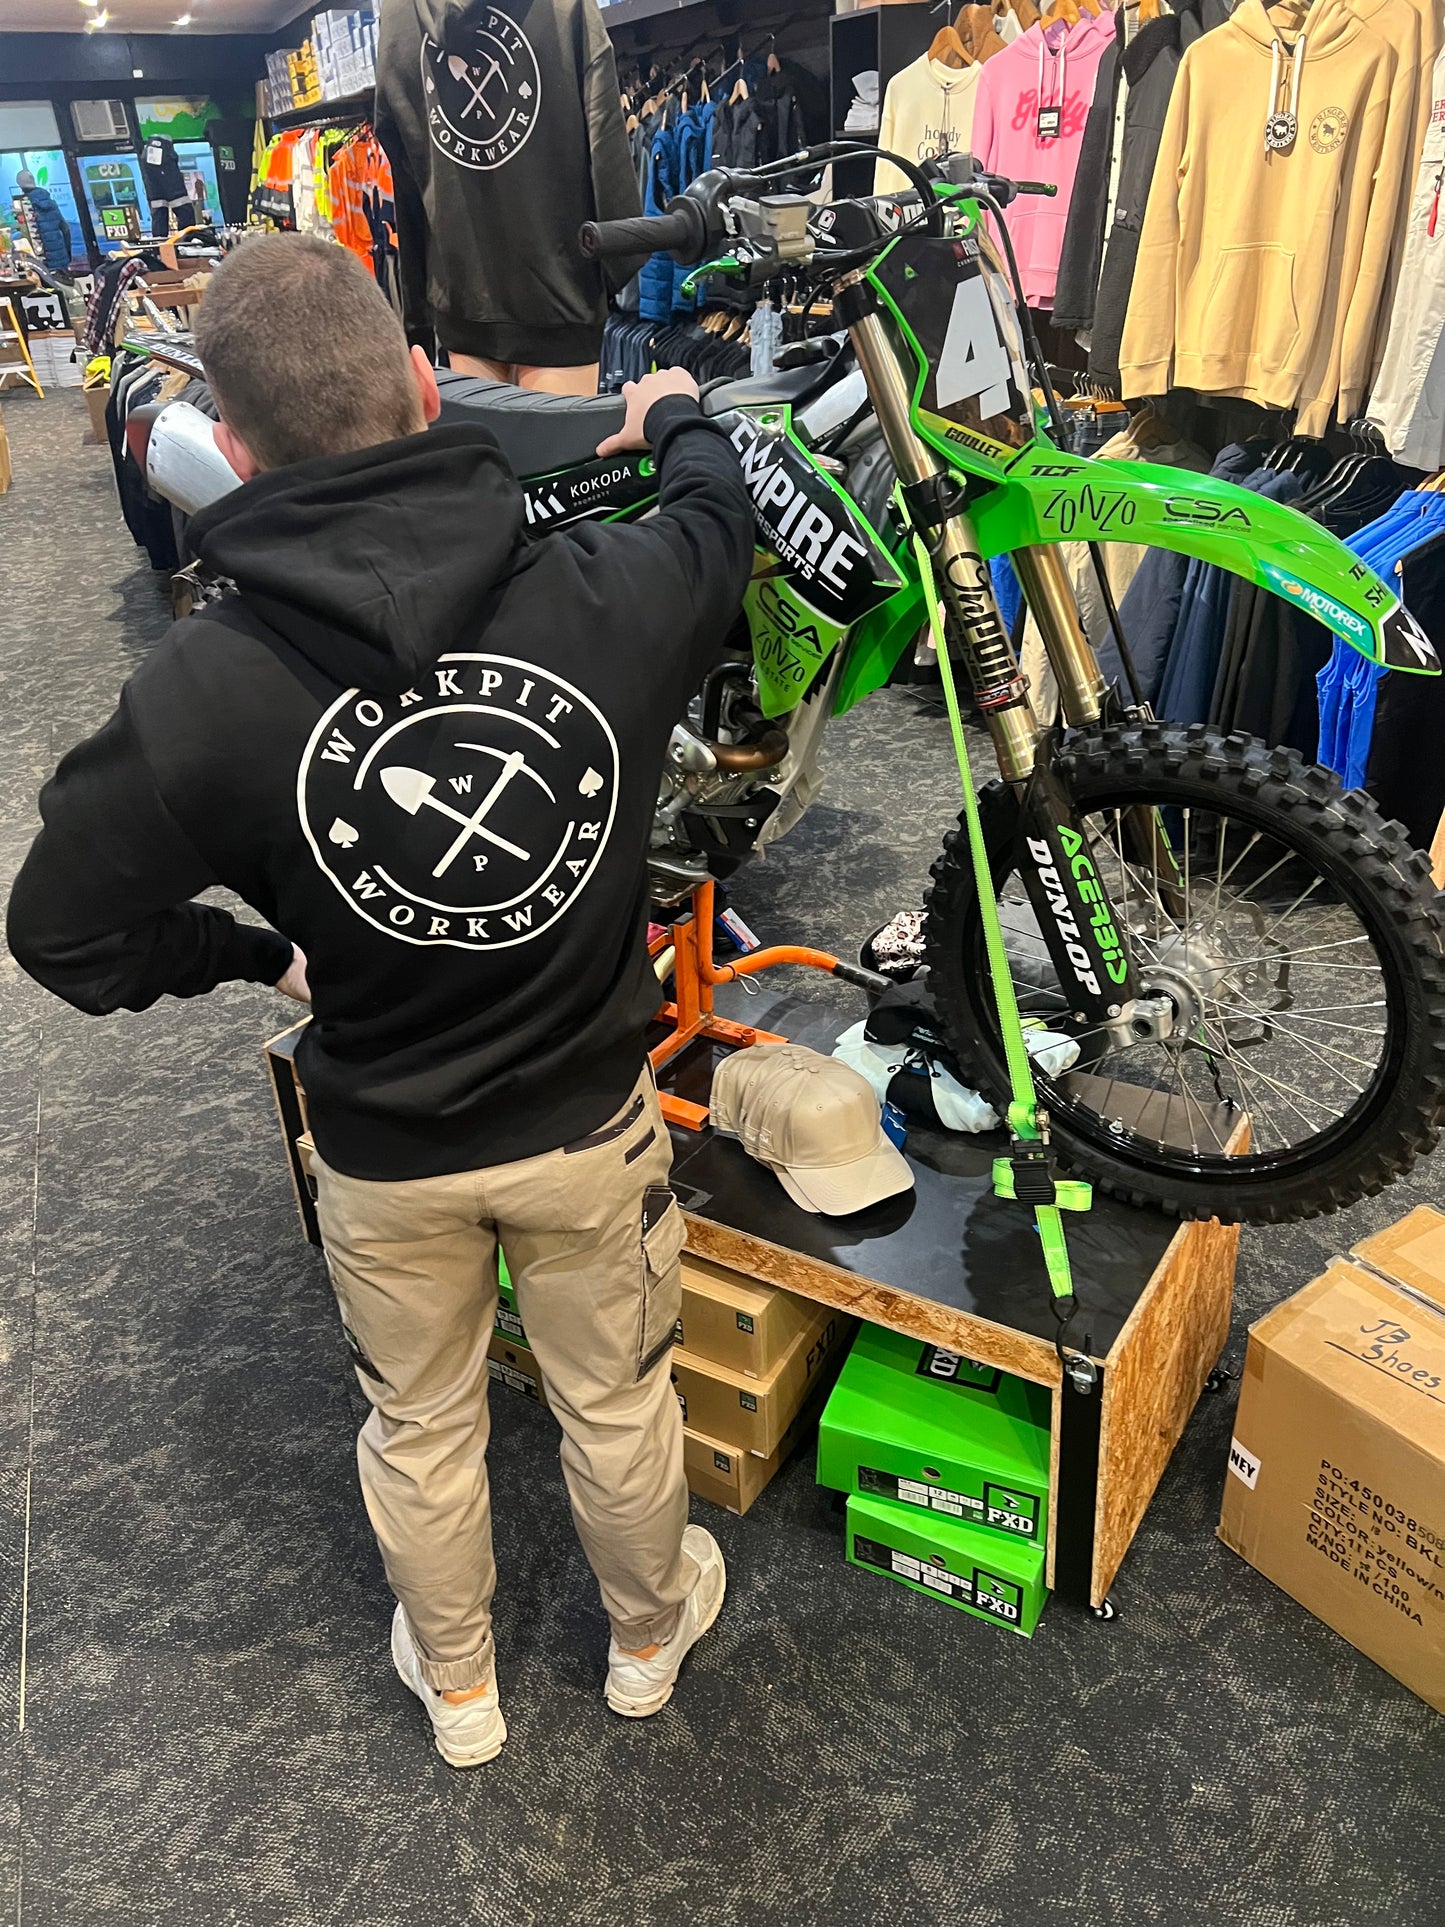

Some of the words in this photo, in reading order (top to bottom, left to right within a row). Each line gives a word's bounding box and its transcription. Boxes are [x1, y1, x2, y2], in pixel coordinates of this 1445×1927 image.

[429, 107, 530, 162] WORKWEAR
[105, 225, 128, 237] FXD
[150, 343, 205, 372] DUNLO
[570, 466, 632, 498] KOKODA
[1030, 465, 1087, 477] TCF
[573, 490, 611, 507] PROPERTY
[729, 419, 869, 590] EMPIRE
[1043, 484, 1137, 534] ZONZO
[1165, 496, 1252, 527] CSA
[759, 581, 823, 655] CSA
[1300, 587, 1367, 637] MOTOREX
[756, 624, 805, 682] ZONZO
[449, 774, 474, 794] W
[473, 855, 489, 871] P
[352, 821, 602, 938] WORKWEAR
[1026, 836, 1102, 995] DUNLOP
[1360, 1319, 1411, 1344] JB
[805, 1318, 836, 1379] FXD
[929, 1347, 960, 1377] XD
[1361, 1344, 1442, 1388] Shoes
[1230, 1448, 1256, 1479] NEY
[987, 1506, 1033, 1533] FXD
[1315, 1487, 1356, 1520] SIZE:
[1318, 1473, 1369, 1515] STYLE
[1372, 1510, 1401, 1538] NO:
[1406, 1534, 1444, 1568] BKL
[1308, 1523, 1353, 1560] C/NO:
[1306, 1533, 1350, 1572] MADE
[1353, 1568, 1370, 1585] IN
[1372, 1583, 1424, 1627] CHINA
[1365, 1549, 1398, 1579] PCS
[976, 1590, 1018, 1619] FXD
